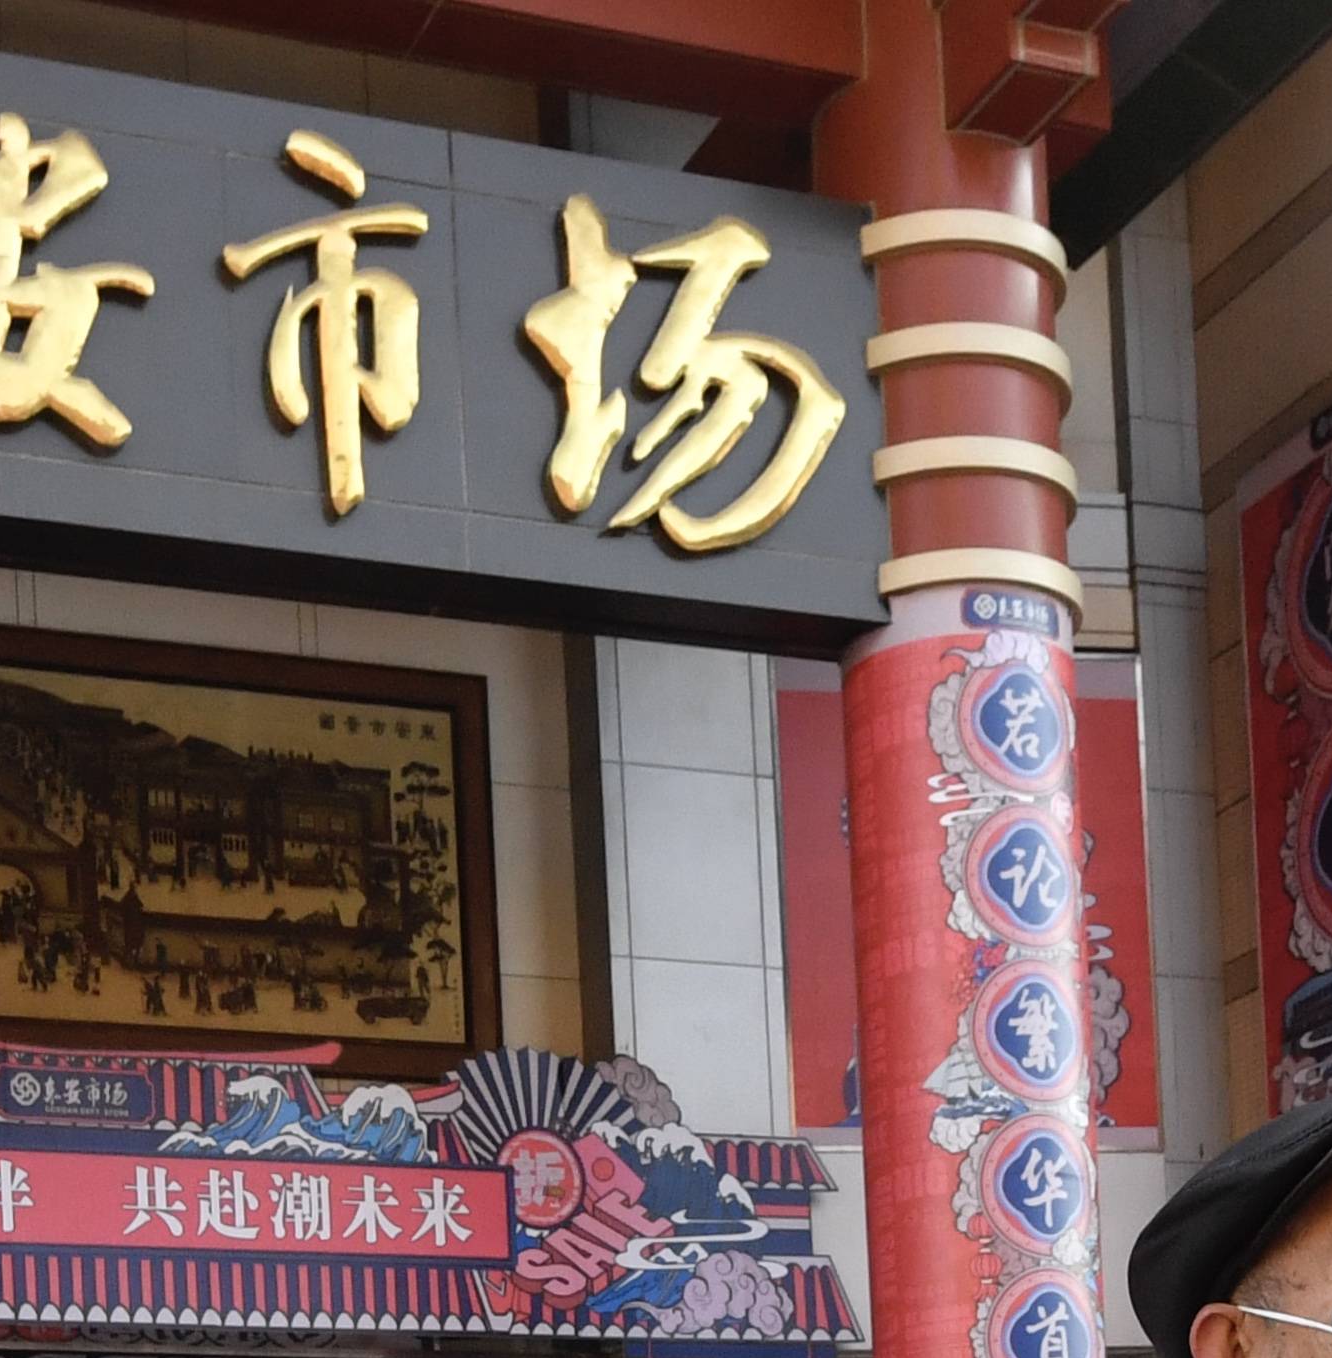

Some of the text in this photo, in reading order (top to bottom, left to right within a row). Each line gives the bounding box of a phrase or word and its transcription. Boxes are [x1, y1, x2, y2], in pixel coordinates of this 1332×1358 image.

[122, 1164, 474, 1248] 共赴潮未来
[515, 1188, 676, 1306] SALE
